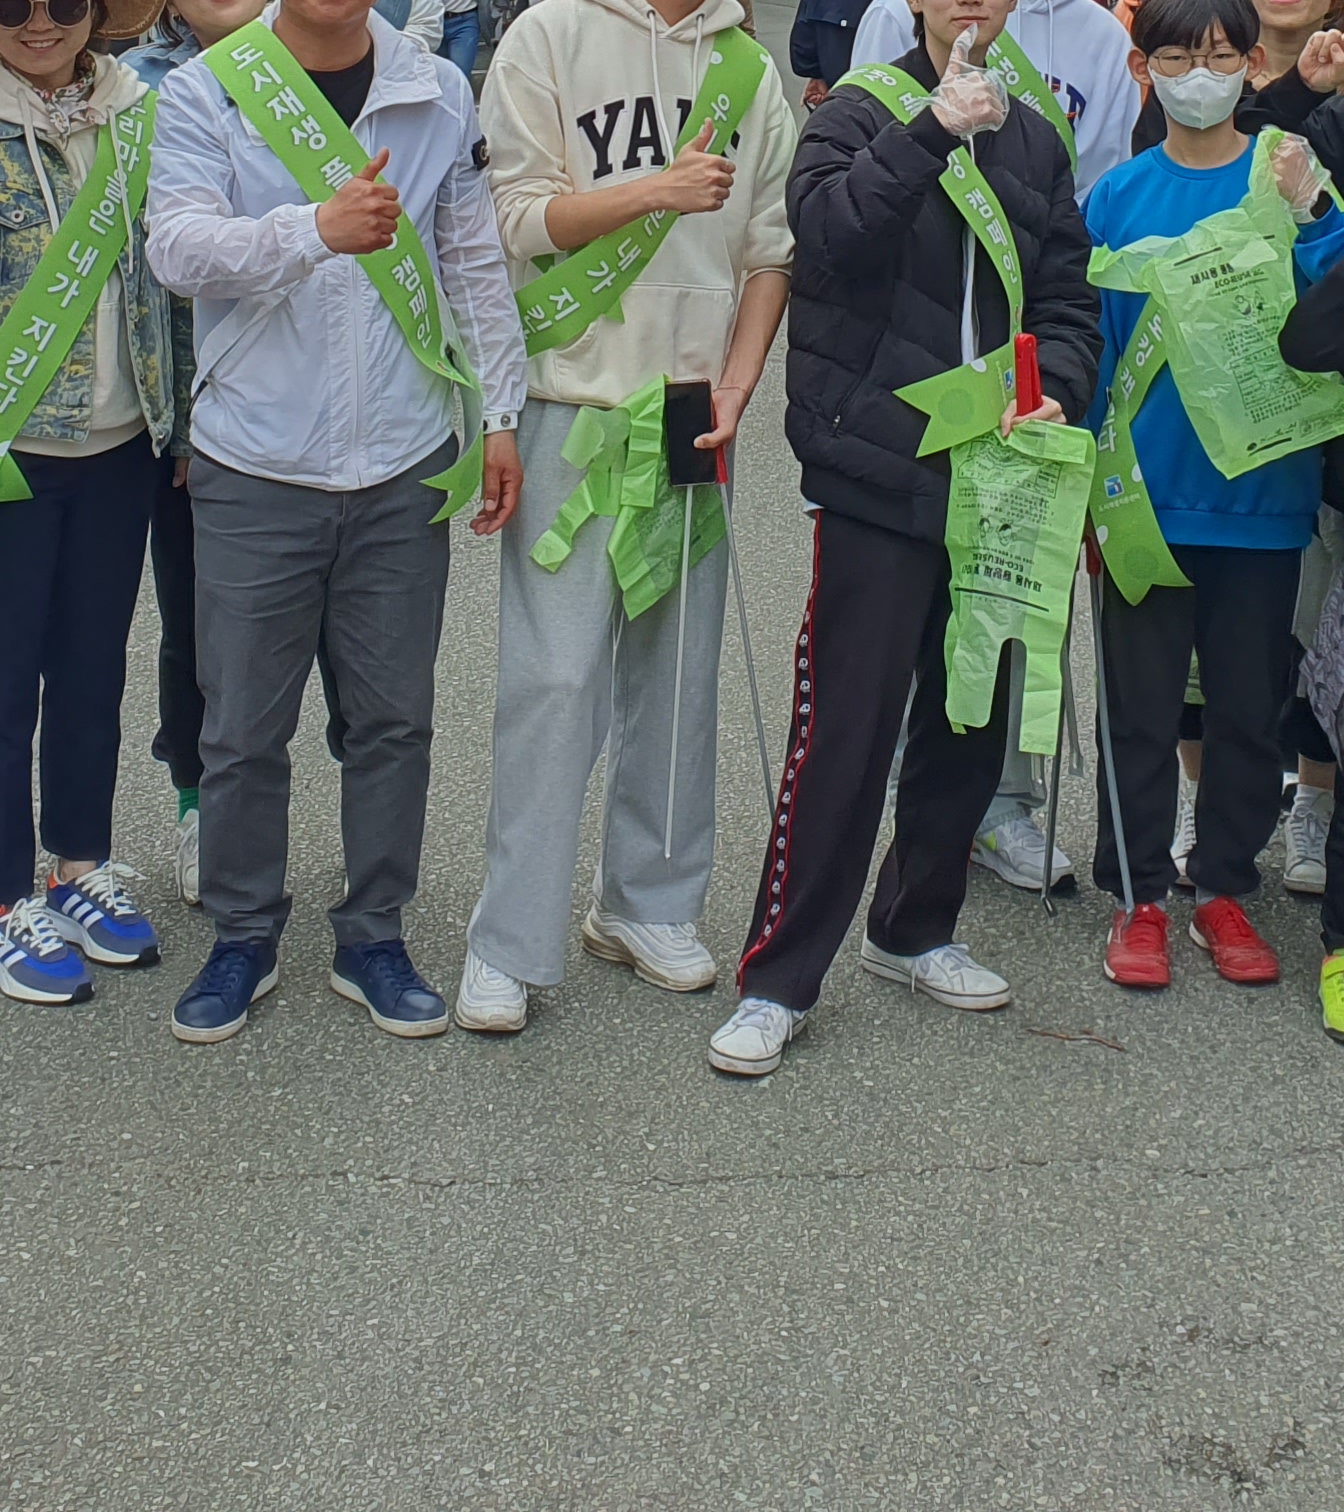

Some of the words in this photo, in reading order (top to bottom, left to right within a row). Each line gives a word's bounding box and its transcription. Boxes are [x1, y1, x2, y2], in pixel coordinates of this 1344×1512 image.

[230, 42, 327, 151] 도시재생
[391, 253, 434, 350] 캠페인
[586, 236, 642, 294] 내가
[964, 187, 1018, 285] 캠페인
[47, 240, 100, 309] 내가
[524, 286, 581, 340] 지킨
